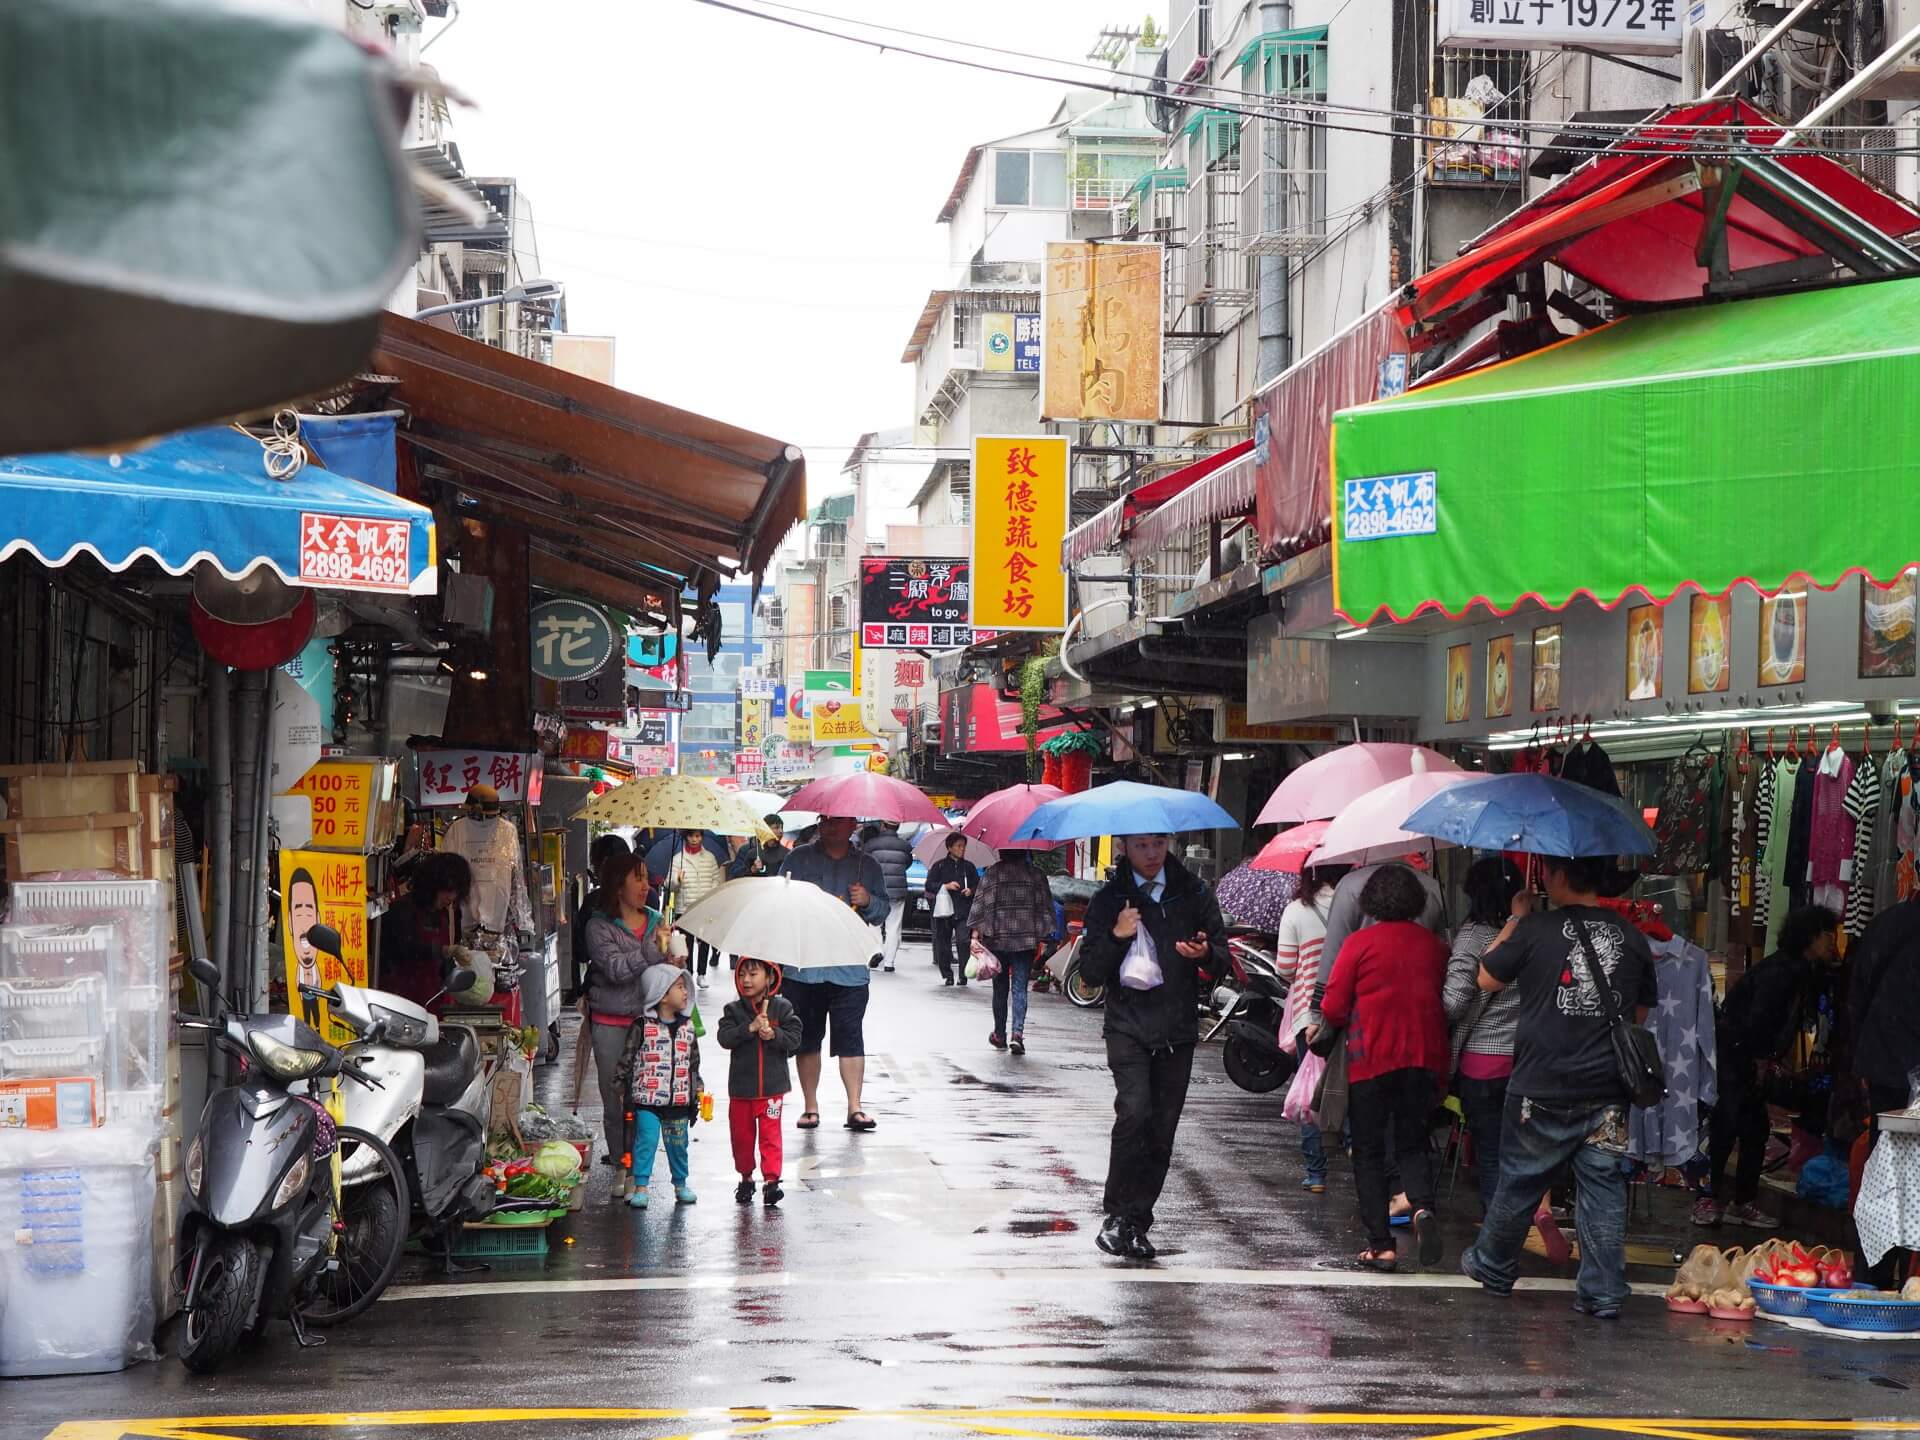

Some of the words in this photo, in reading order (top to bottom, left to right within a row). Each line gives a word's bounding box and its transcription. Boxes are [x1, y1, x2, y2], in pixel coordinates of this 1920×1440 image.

[1016, 359, 1040, 370] TEL:
[1348, 476, 1433, 512] 大全帆布
[1003, 447, 1038, 618] 致德蔬食坊
[1348, 505, 1433, 536] 2898-4692
[303, 517, 407, 560] 大全帆布
[303, 551, 406, 583] 2898-4692
[931, 606, 942, 617] to
[945, 609, 959, 620] go
[536, 615, 597, 667] 花
[821, 720, 868, 735] 公益彩
[422, 754, 522, 795] 紅豆餅
[1731, 790, 1741, 917] DESPICABLE
[321, 863, 363, 897] 小胖子
